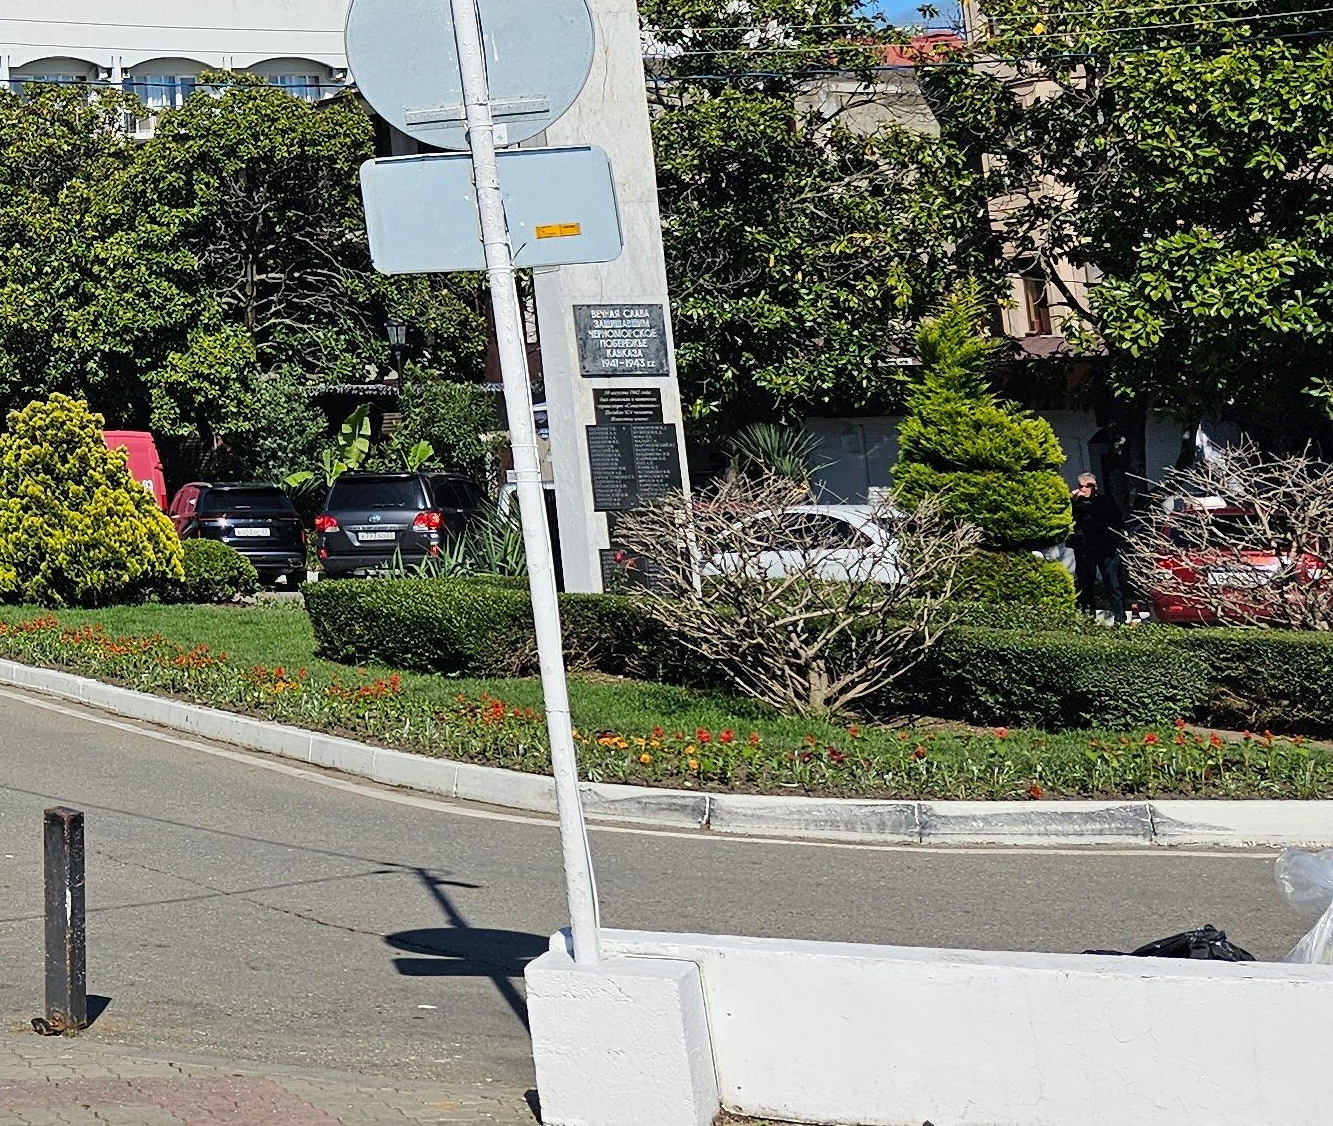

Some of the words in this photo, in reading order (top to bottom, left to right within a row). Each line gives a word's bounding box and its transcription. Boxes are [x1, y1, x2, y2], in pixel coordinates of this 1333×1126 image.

[591, 309, 620, 318] ВЕЧНАЯ
[623, 309, 650, 318] СЛАВА
[606, 349, 643, 357] КАВКАЗА
